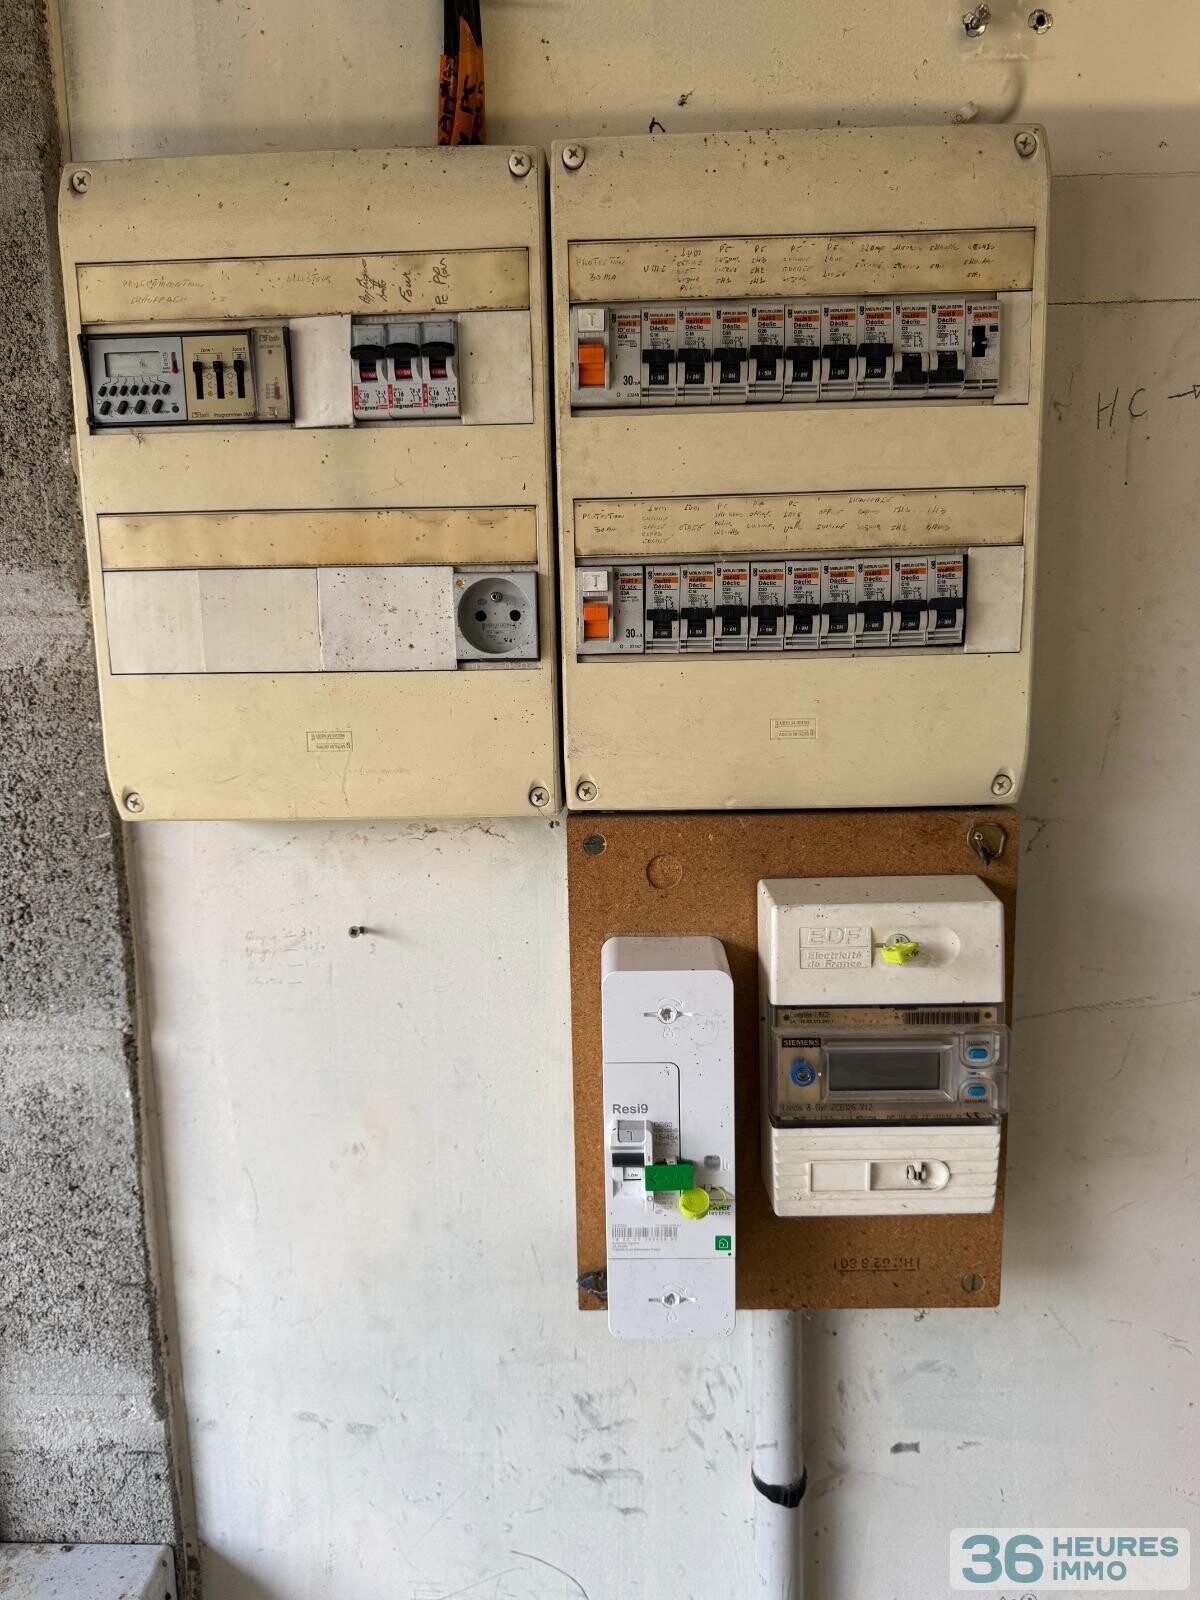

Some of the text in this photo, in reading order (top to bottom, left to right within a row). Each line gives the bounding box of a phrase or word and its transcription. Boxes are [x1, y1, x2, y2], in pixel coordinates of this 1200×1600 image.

[623, 375, 633, 385] 30
[625, 628, 635, 638] 30
[810, 928, 862, 945] EDF
[807, 960, 863, 968] de France
[612, 1103, 649, 1114] Resi9
